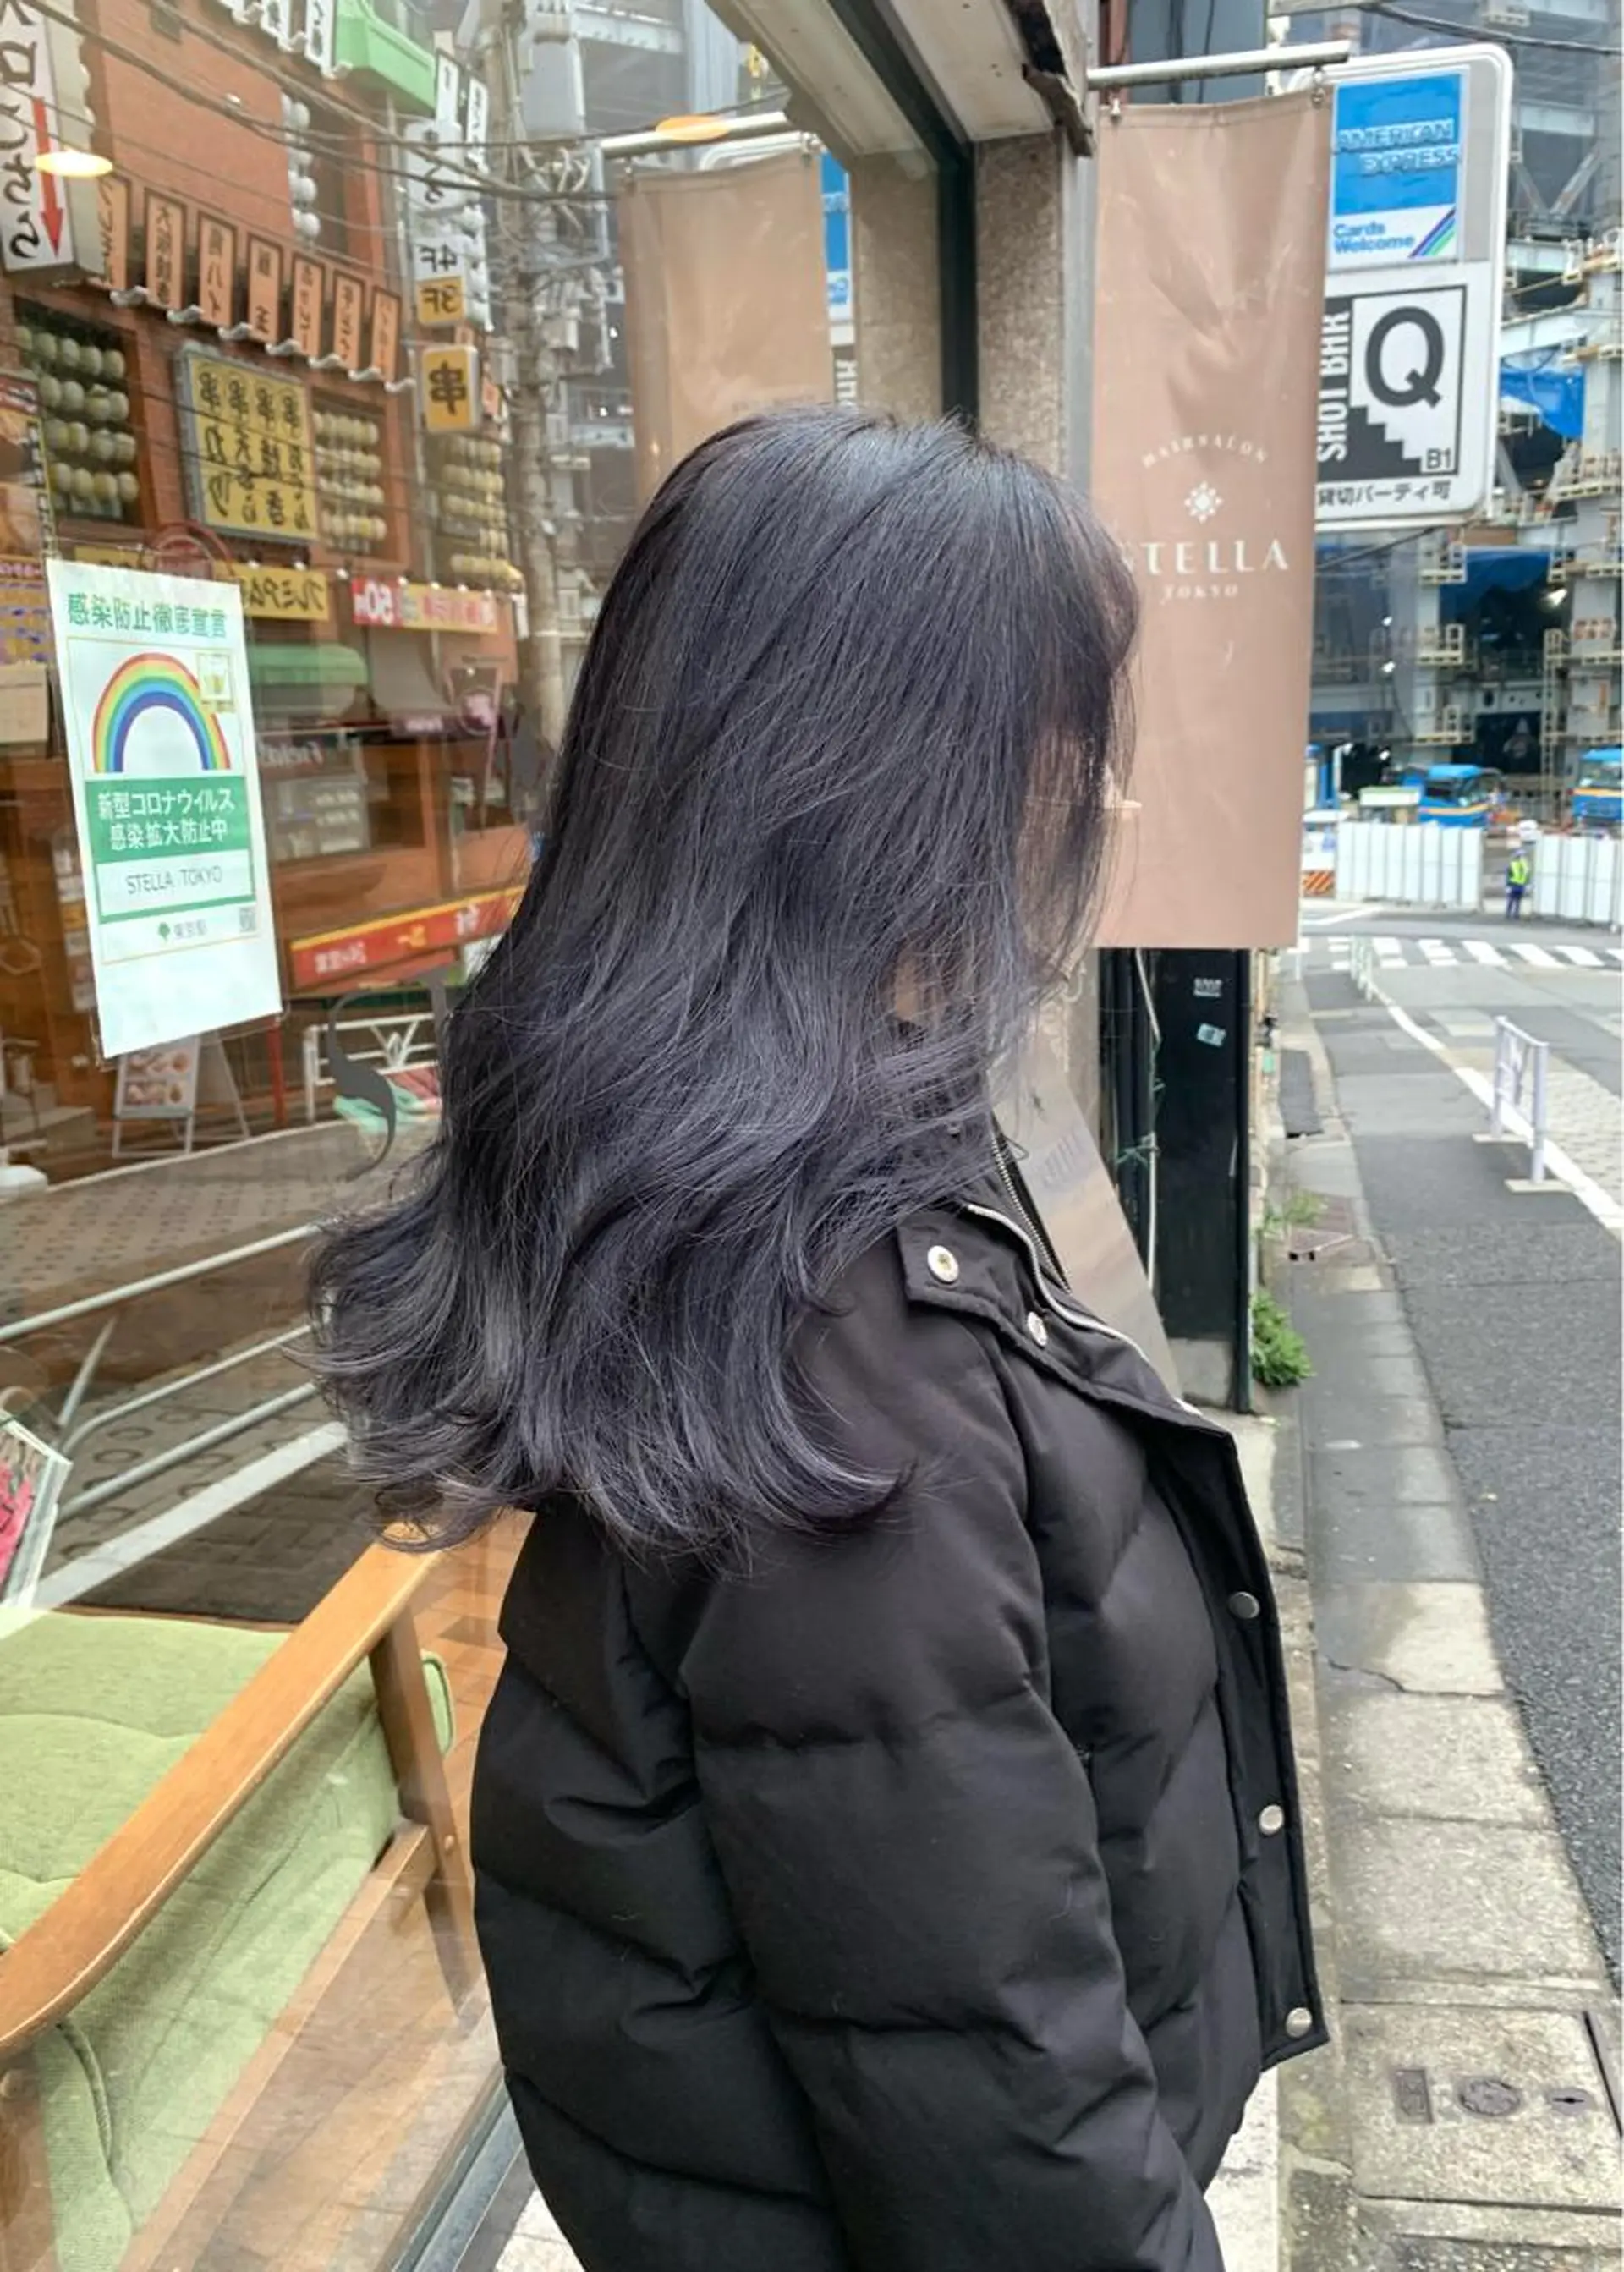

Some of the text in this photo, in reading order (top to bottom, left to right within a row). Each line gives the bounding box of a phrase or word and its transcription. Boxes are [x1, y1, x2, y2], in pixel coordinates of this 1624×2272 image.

[1334, 221, 1385, 239] Cards
[1335, 235, 1415, 254] Welcome
[1365, 305, 1445, 409] Q
[1316, 387, 1348, 463] SHOT
[1426, 448, 1451, 469] B1
[1125, 538, 1289, 576] TELLA
[110, 815, 228, 851] 感染拡大防止中
[126, 865, 222, 895] STELLA TOKYO
